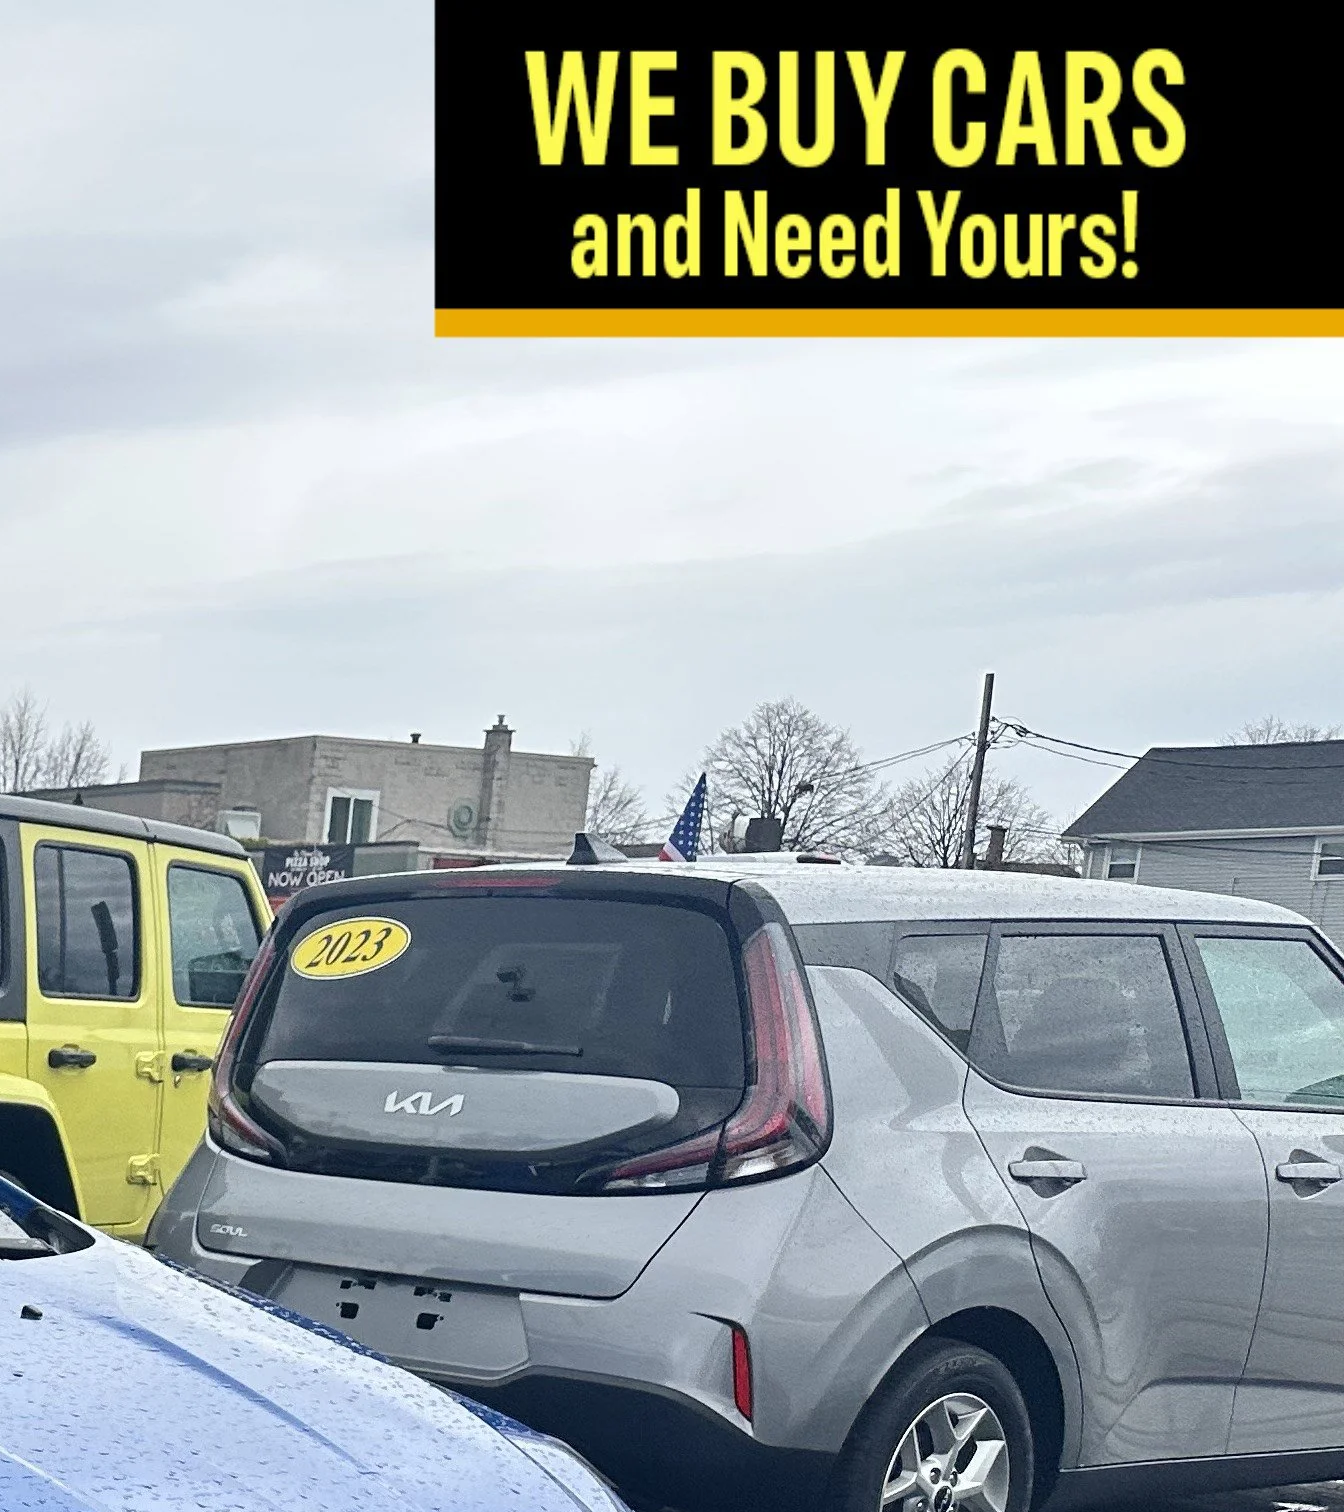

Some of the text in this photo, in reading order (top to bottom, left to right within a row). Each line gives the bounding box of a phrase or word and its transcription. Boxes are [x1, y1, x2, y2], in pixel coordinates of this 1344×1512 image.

[268, 870, 345, 888] NOW OPEN
[306, 928, 391, 969] 2023
[210, 1224, 248, 1237] SOUL
